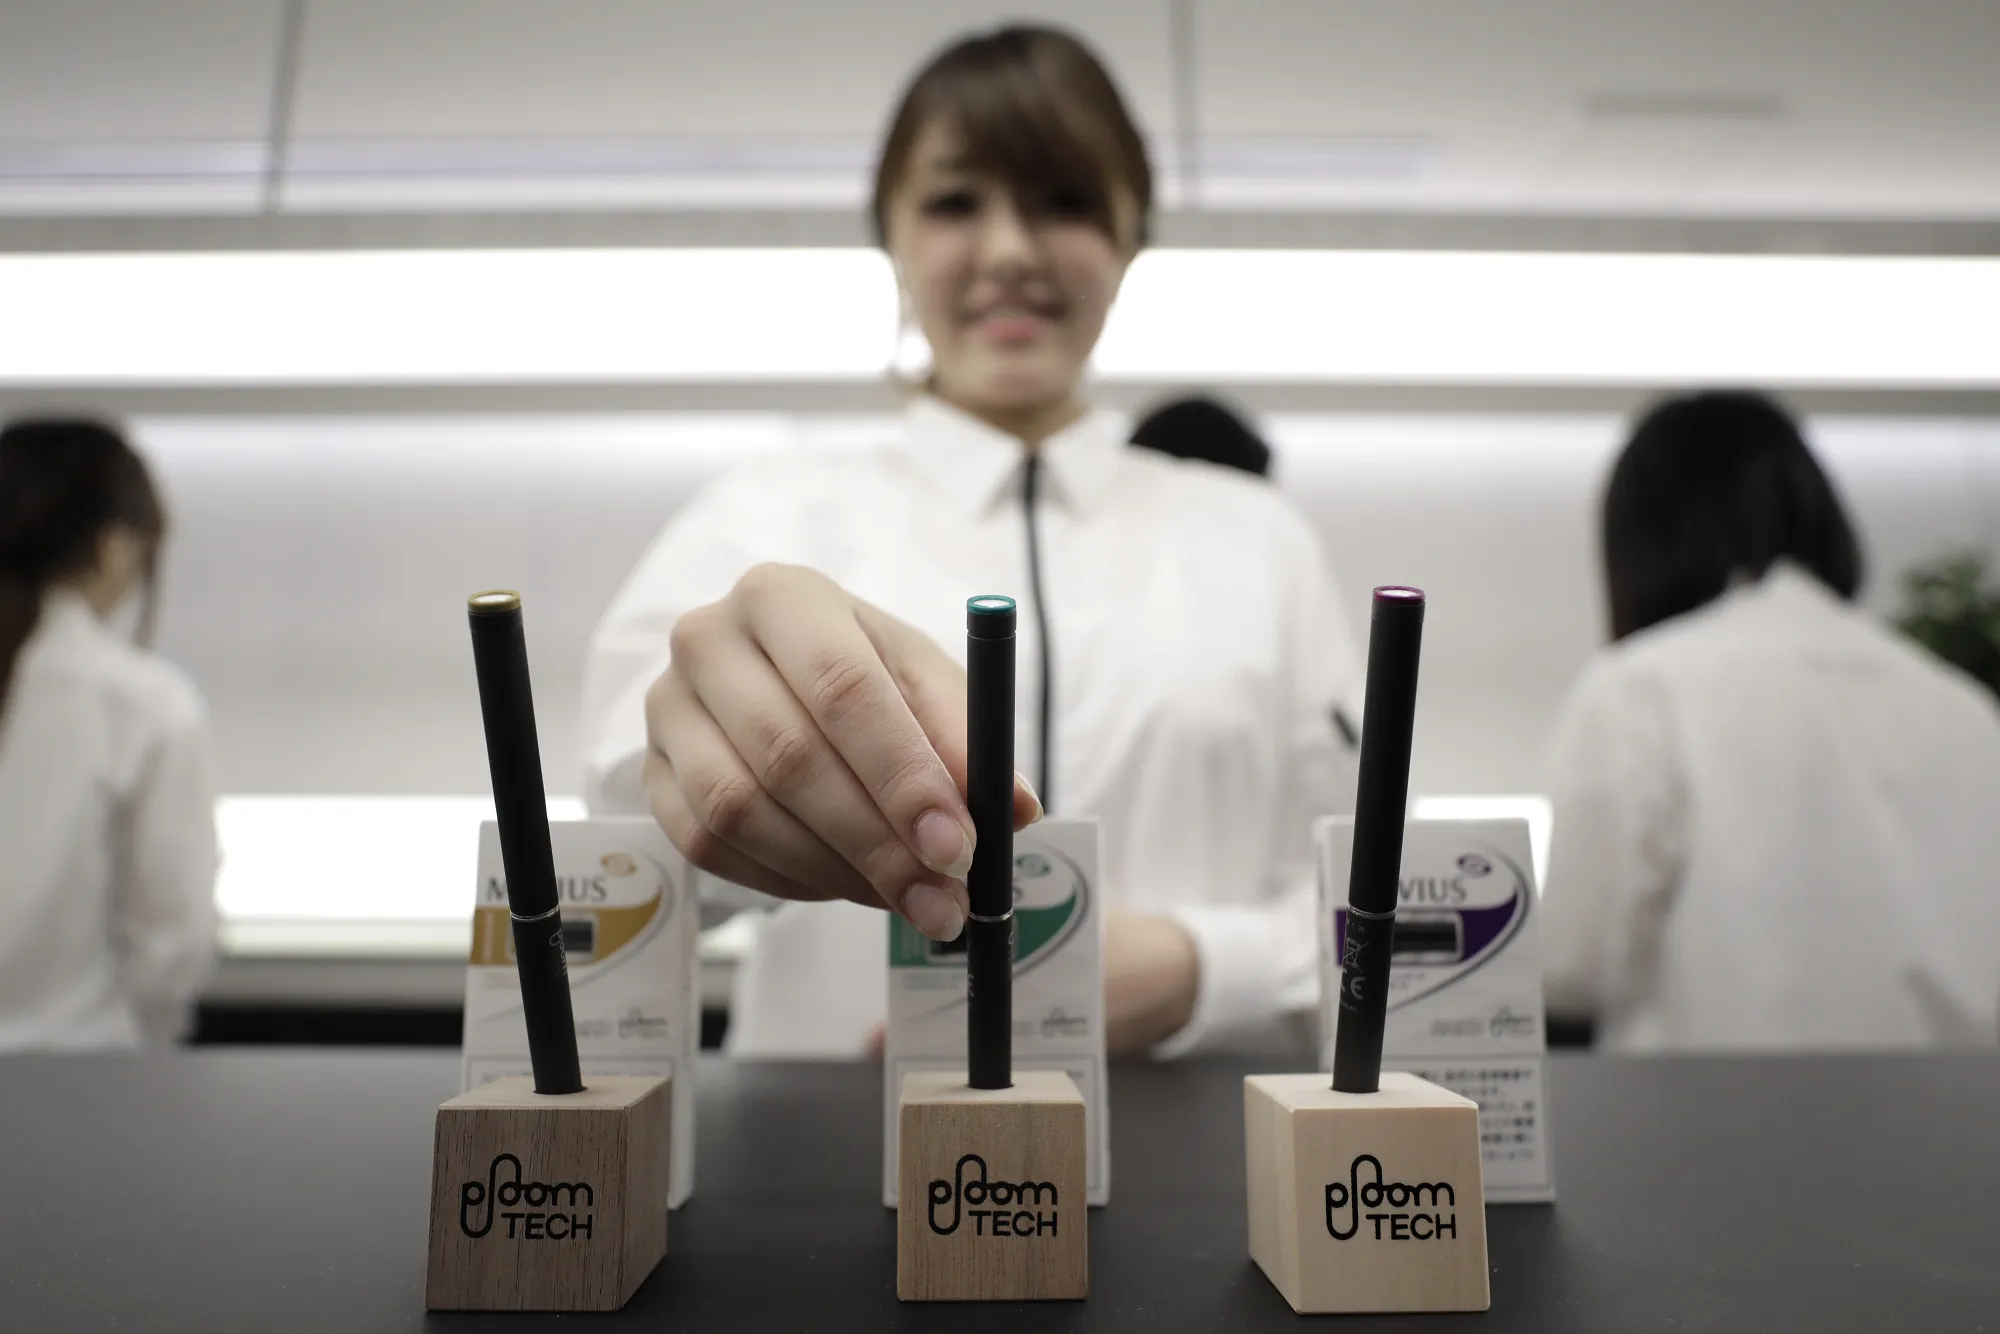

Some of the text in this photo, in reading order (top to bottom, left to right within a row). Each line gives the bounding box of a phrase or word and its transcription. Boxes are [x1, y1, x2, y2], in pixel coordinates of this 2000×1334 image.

[486, 876, 608, 902] MIUS
[1398, 876, 1468, 903] VIUS
[460, 1153, 594, 1239] ploom
[928, 1154, 1058, 1235] ploom
[1325, 1154, 1455, 1240] ploom
[501, 1213, 592, 1240] TECH
[968, 1210, 1058, 1237] TECH
[1365, 1213, 1457, 1240] TECH
